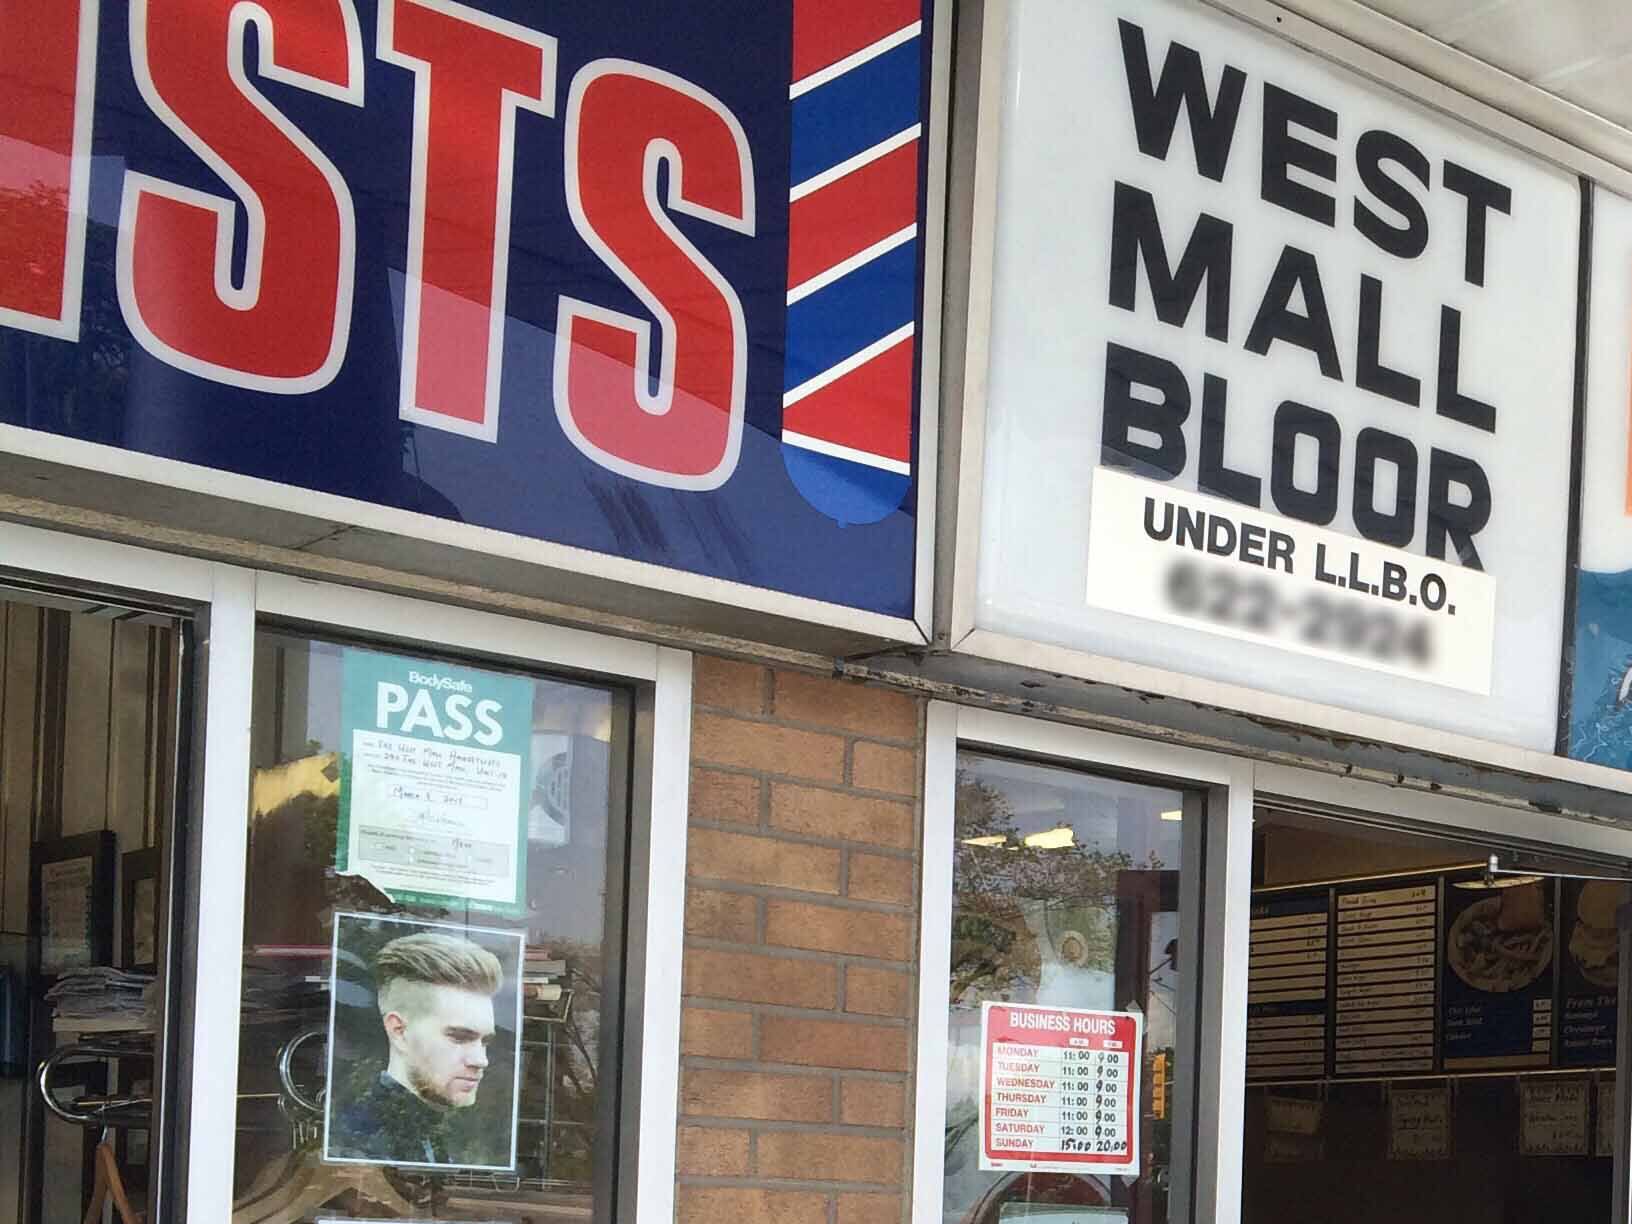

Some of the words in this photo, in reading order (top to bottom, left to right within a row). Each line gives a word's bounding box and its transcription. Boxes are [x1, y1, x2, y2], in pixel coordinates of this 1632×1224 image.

[1117, 17, 1512, 288] WEST
[1108, 180, 1496, 434] MALL
[1100, 341, 1492, 571] BLOOR
[1143, 497, 1296, 574] UNDER
[1314, 543, 1456, 615] L.L.B.O.
[408, 670, 473, 693] BodySafe
[376, 681, 504, 746] PASS
[1010, 1012, 1072, 1030] BUSINESS
[1073, 1018, 1116, 1035] HOURS
[997, 1046, 1039, 1057] MONDAY
[998, 1061, 1040, 1073] TUESDAY
[997, 1077, 1056, 1089] WEDNESDAY
[997, 1092, 1047, 1104] THURSDAY
[995, 1107, 1030, 1118] FRIDAY
[995, 1123, 1046, 1134] SATURDAY
[995, 1137, 1034, 1149] SUNDAY
